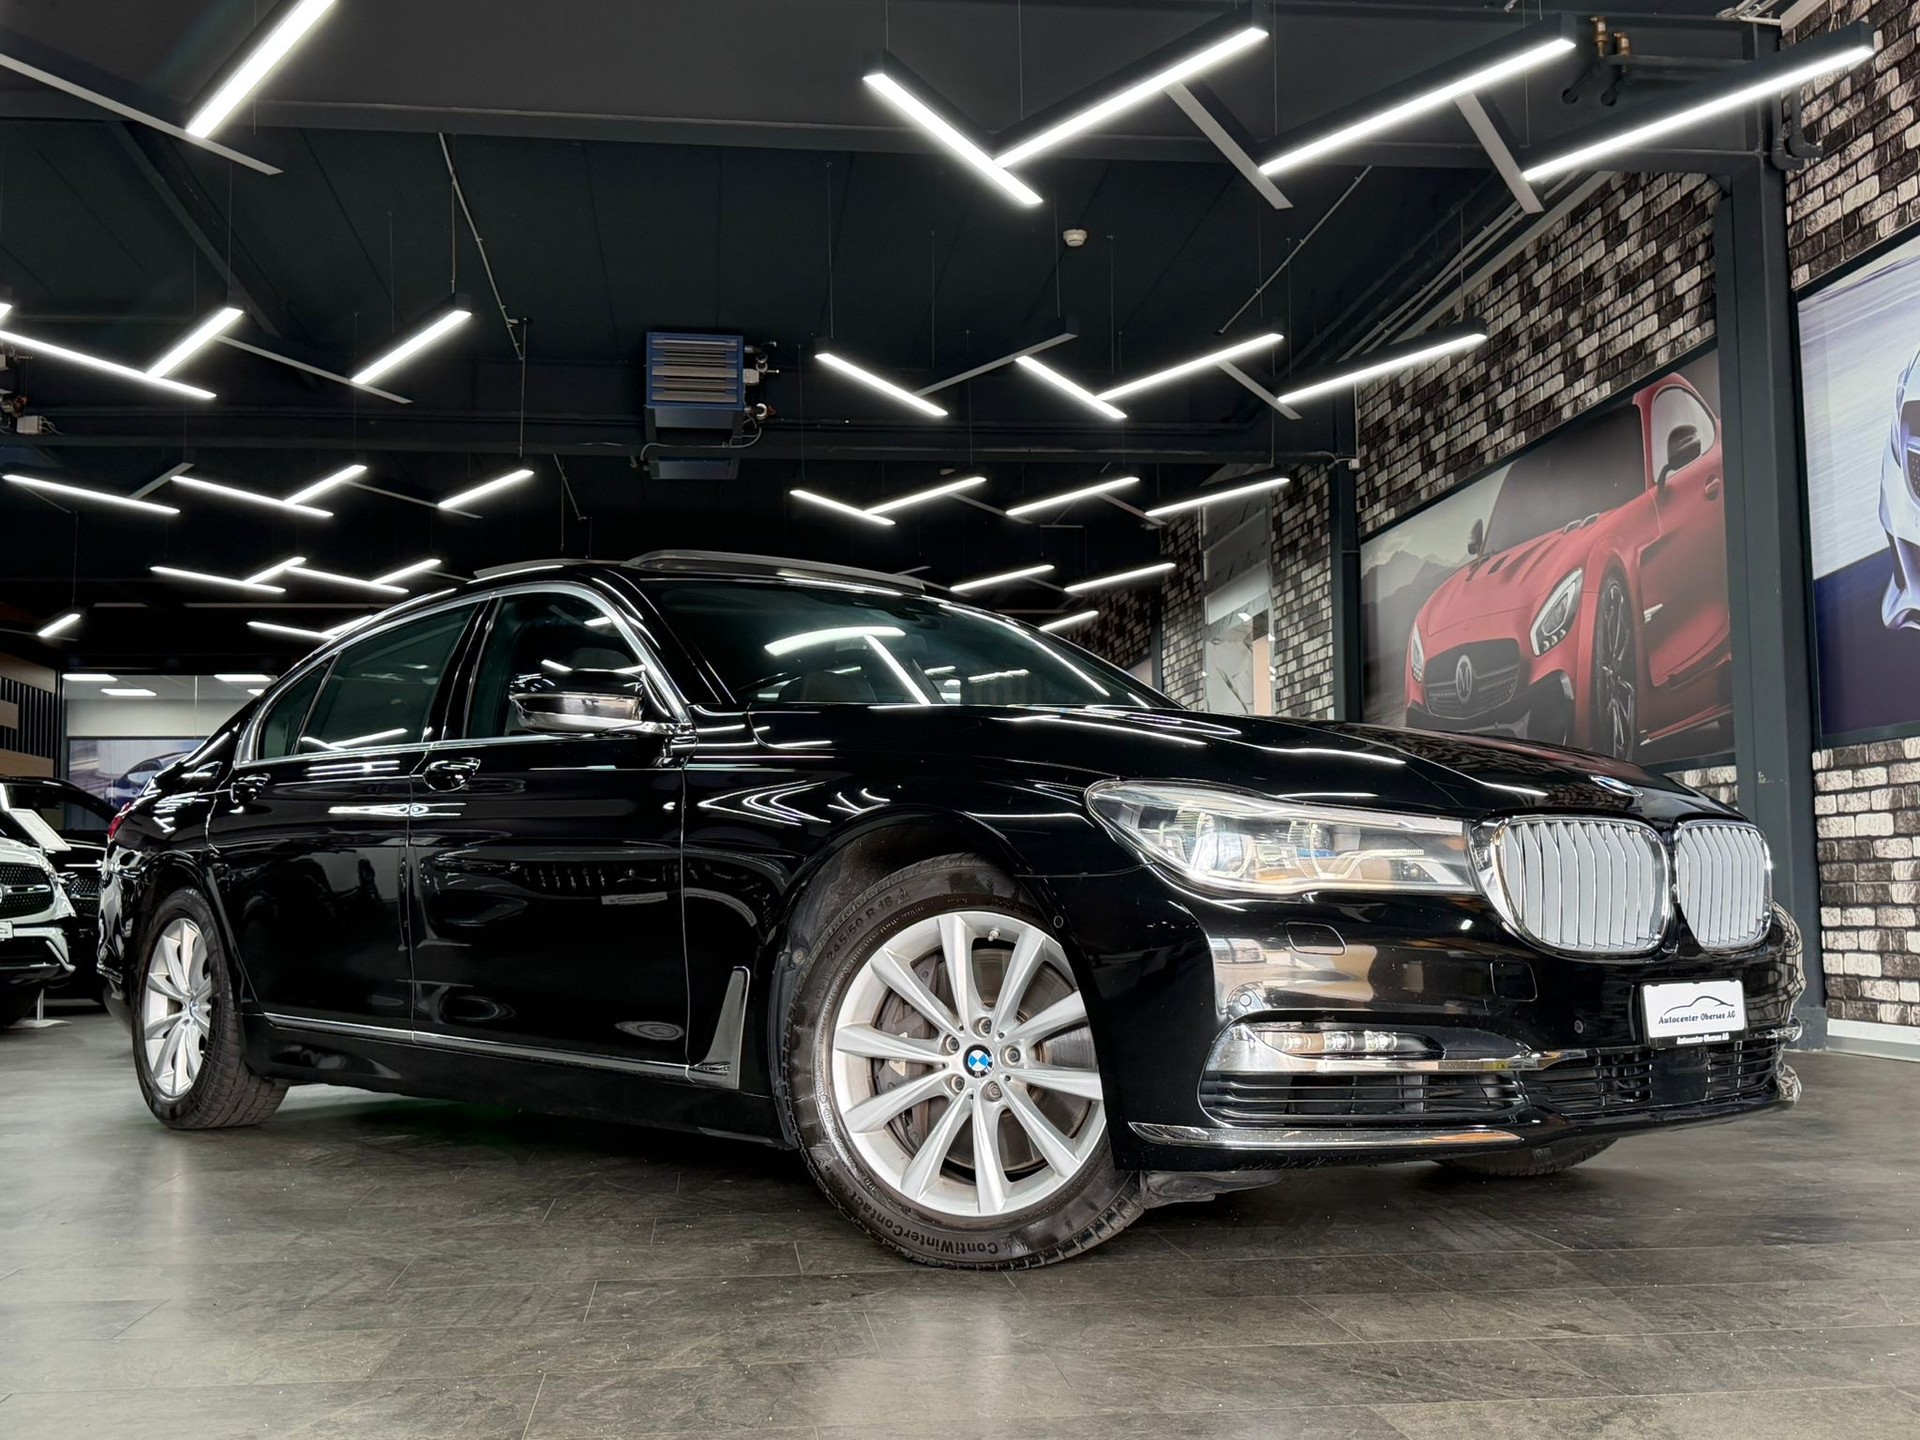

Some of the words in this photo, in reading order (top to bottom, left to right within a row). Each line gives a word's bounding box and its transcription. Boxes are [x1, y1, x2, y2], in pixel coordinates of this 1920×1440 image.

[866, 907, 875, 919] R
[1658, 1015, 1699, 1025] Autocenter
[1700, 1012, 1725, 1021] Obersee
[1727, 1010, 1736, 1019] AG
[849, 1189, 999, 1255] ContiWinterContact
